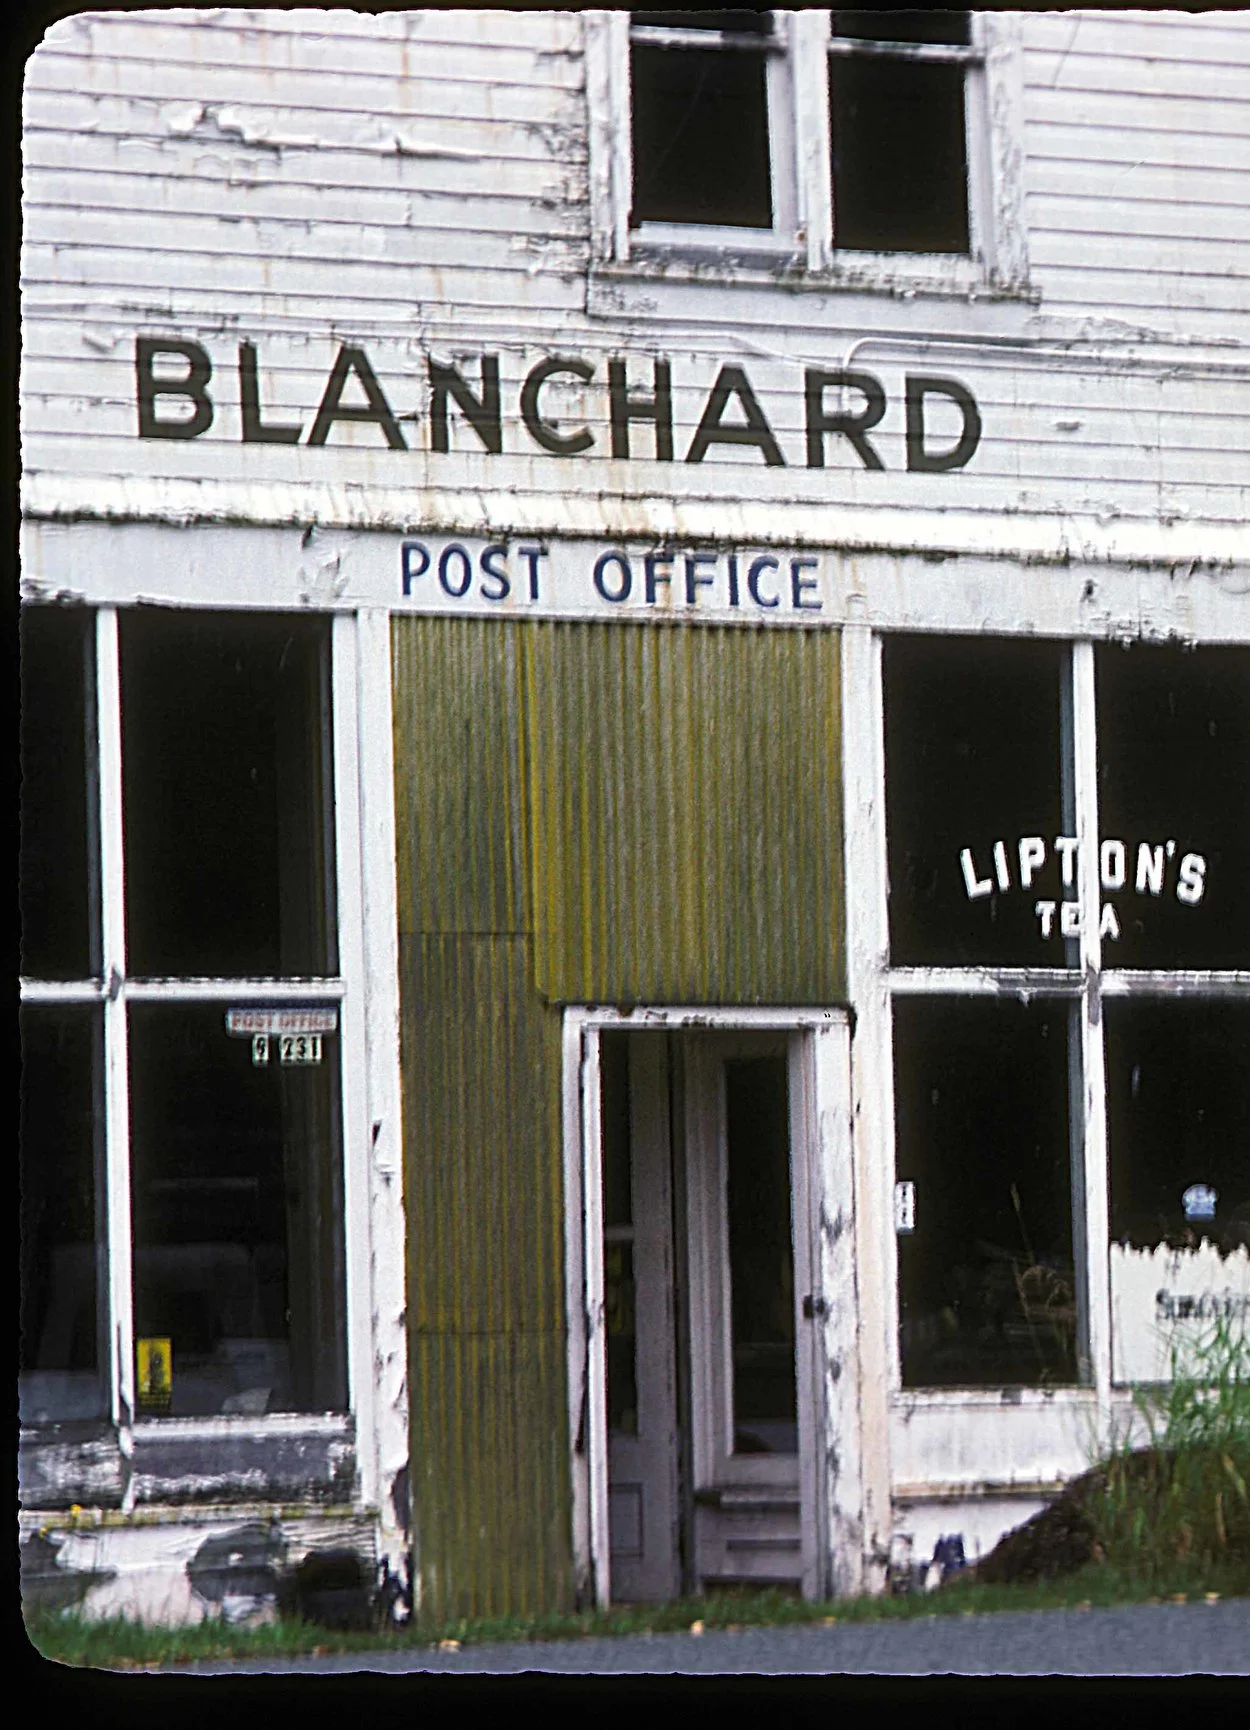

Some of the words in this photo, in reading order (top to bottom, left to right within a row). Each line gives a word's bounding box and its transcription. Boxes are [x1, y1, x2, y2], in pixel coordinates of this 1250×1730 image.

[134, 335, 983, 473] BLANCHARD
[401, 541, 549, 600] POST
[593, 549, 824, 610] OFFICE
[959, 836, 1207, 906] LIPTON'S
[1035, 900, 1121, 940] TEA
